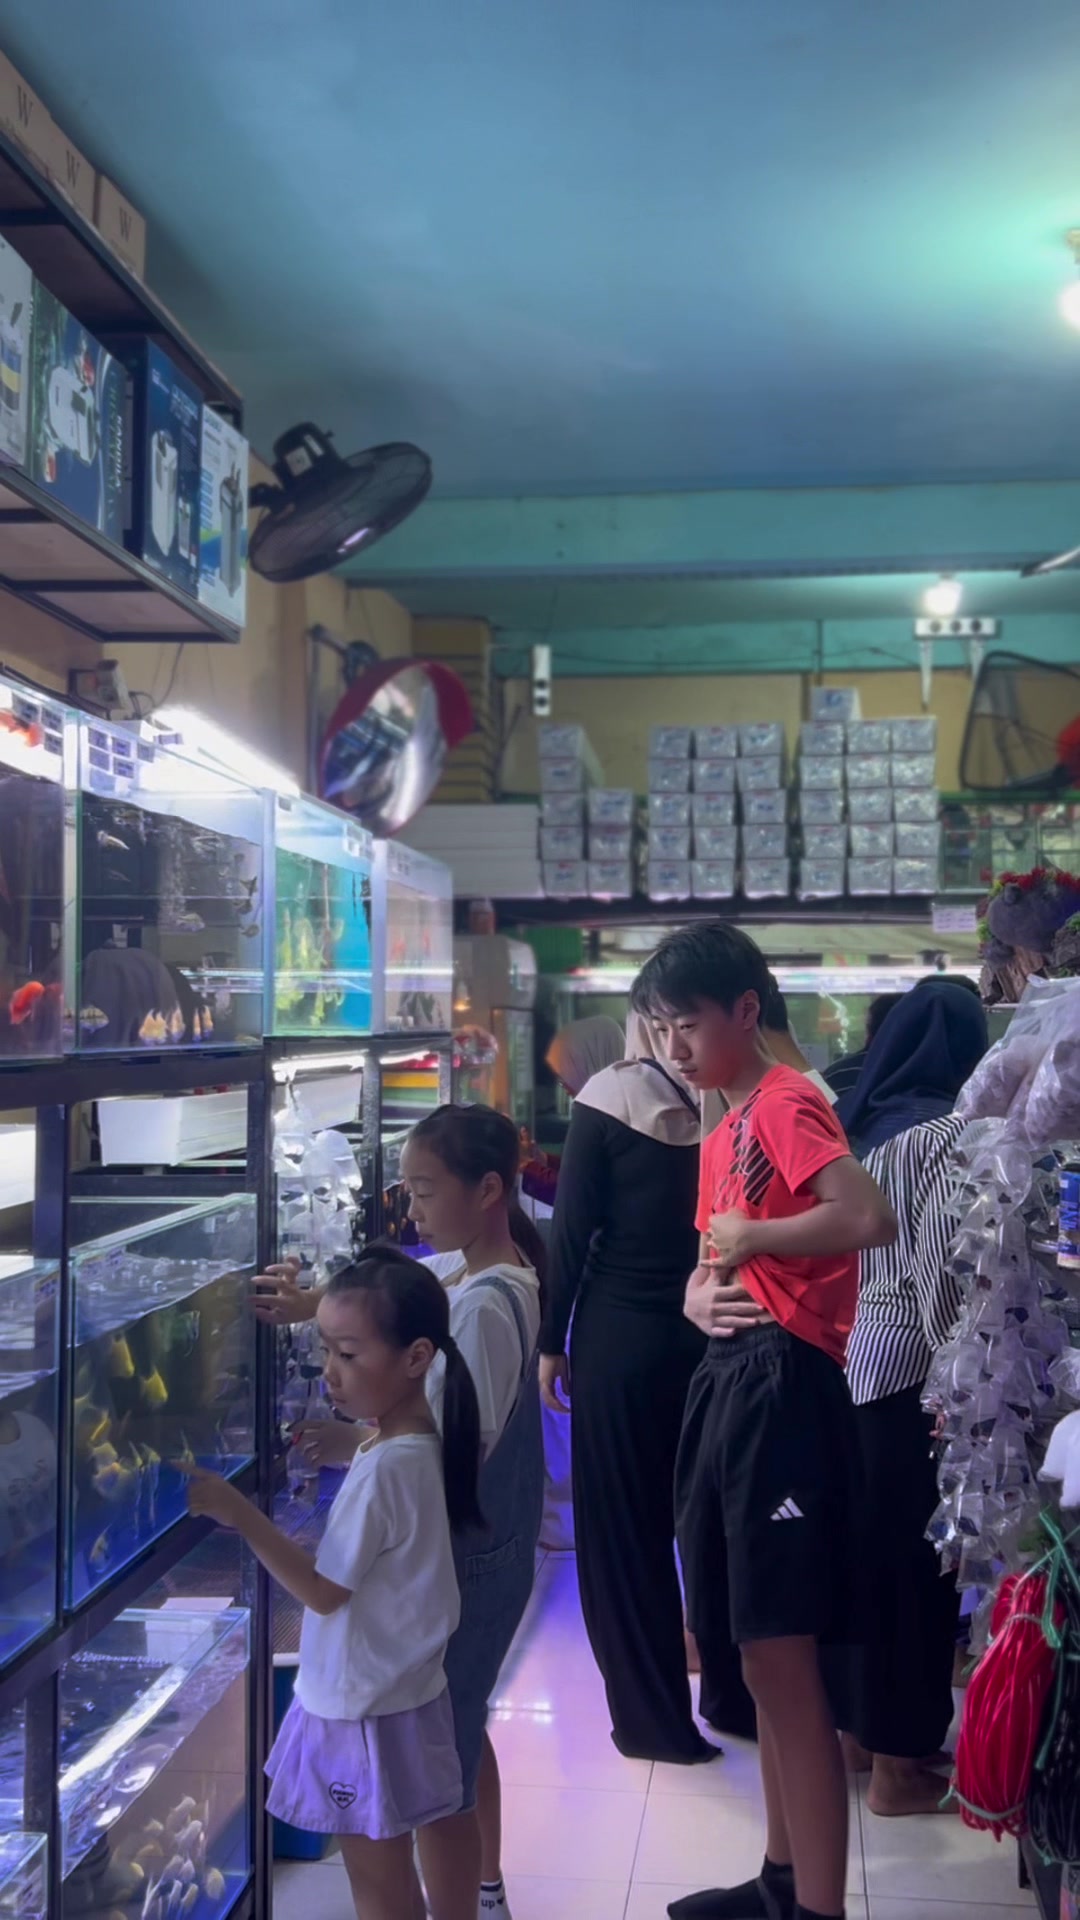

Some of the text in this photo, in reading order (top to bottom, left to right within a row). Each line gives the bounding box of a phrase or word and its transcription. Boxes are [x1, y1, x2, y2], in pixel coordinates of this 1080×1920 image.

[17, 85, 33, 128] W
[66, 150, 80, 188] W
[481, 1899, 496, 1910] up
